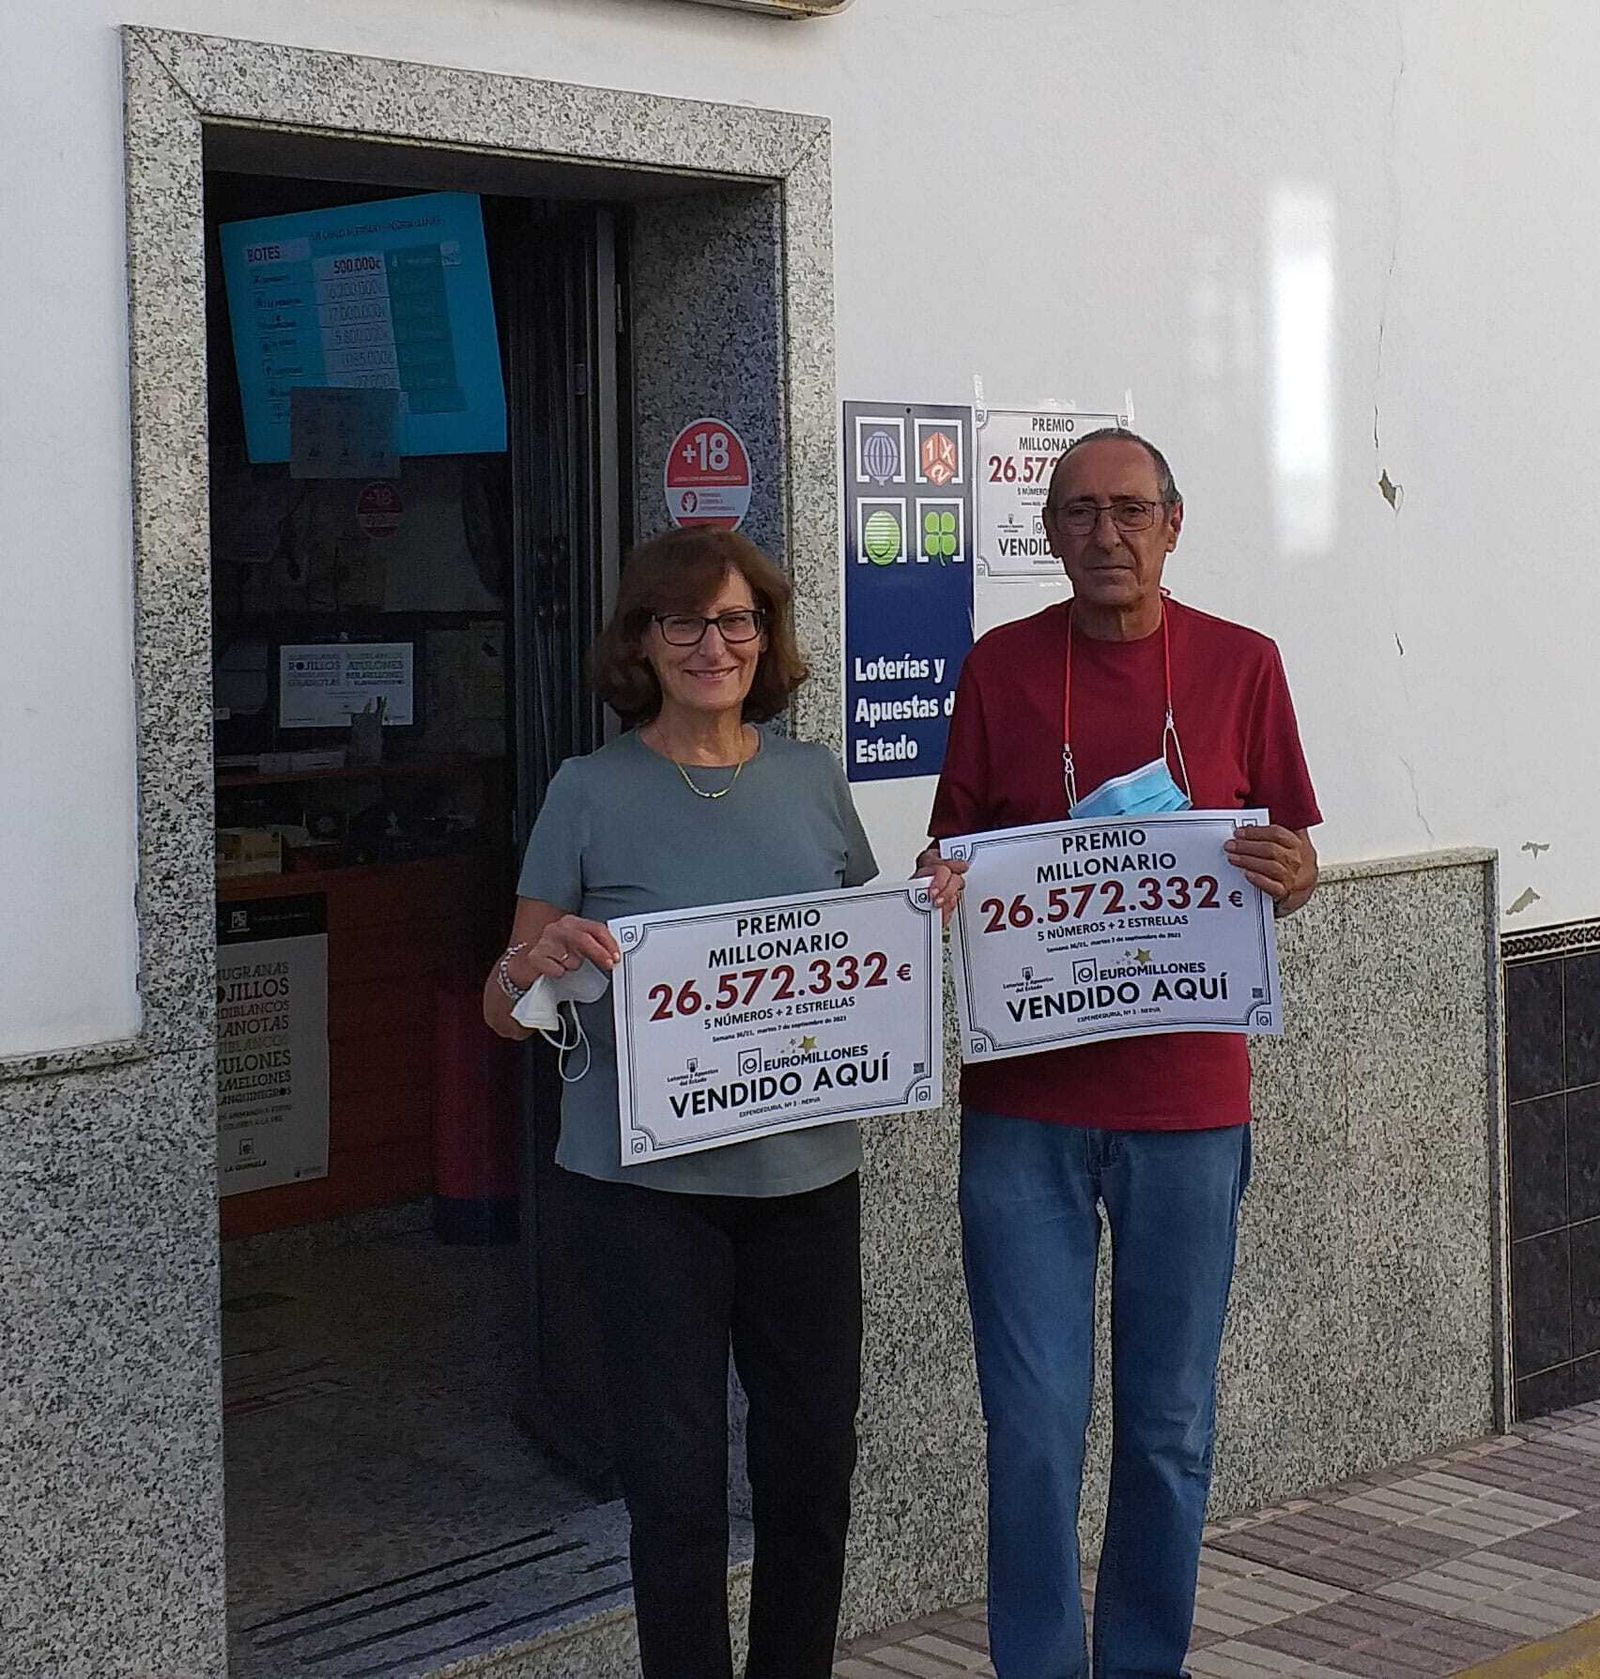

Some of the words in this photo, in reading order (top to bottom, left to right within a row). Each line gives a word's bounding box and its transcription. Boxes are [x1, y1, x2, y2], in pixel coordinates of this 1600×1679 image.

[247, 246, 281, 263] BOTES
[1032, 417, 1074, 432] PREMIO
[682, 432, 730, 472] +18
[855, 653, 930, 682] Loterías
[934, 659, 945, 683] y
[855, 694, 939, 728] Apuestas
[855, 734, 918, 763] Estado
[1062, 829, 1146, 854] PREMIO
[1037, 853, 1177, 884] MILLONARIO
[980, 875, 1220, 934] 26.572.332
[1228, 890, 1244, 908] €
[737, 909, 821, 938] PREMIO
[1037, 931, 1045, 941] 5
[1047, 922, 1106, 940] NÚMEROS
[1118, 918, 1125, 929] 2
[1127, 914, 1189, 928] ESTRELLAS
[708, 931, 849, 968] MILLONARIO
[648, 952, 888, 1021] 26.572.332
[896, 963, 912, 981] €
[1099, 962, 1206, 981] EUROMILLONES
[1006, 982, 1140, 1023] VENDIDO
[1151, 971, 1228, 1001] AQUÍ
[703, 1019, 711, 1029] 5
[714, 1008, 773, 1028] NÚMEROS
[785, 1005, 793, 1016] 2
[796, 996, 855, 1014] ESTRELLAS
[764, 1045, 868, 1071] EUROMILLONES
[669, 1072, 802, 1118] VENDIDO
[813, 1051, 890, 1091] AQUÍ
